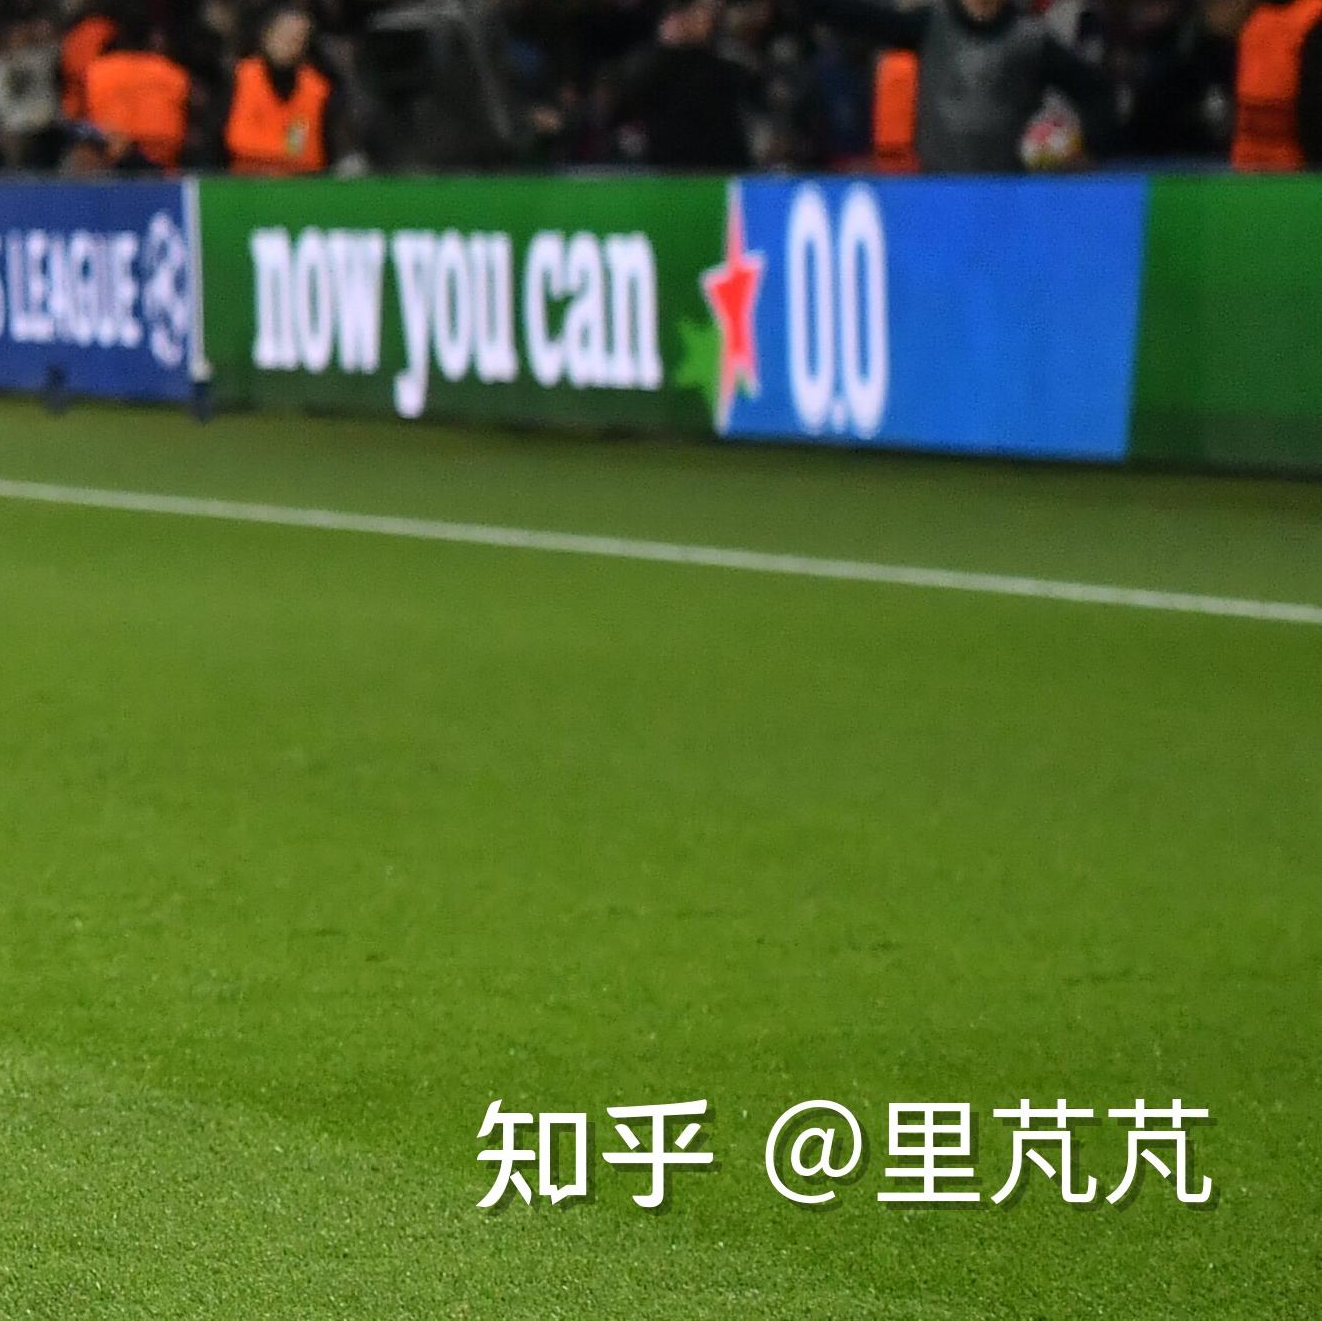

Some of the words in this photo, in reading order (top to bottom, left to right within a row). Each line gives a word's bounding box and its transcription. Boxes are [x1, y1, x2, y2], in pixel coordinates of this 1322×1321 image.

[250, 226, 386, 373] now
[393, 230, 517, 418] you
[525, 230, 662, 390] can
